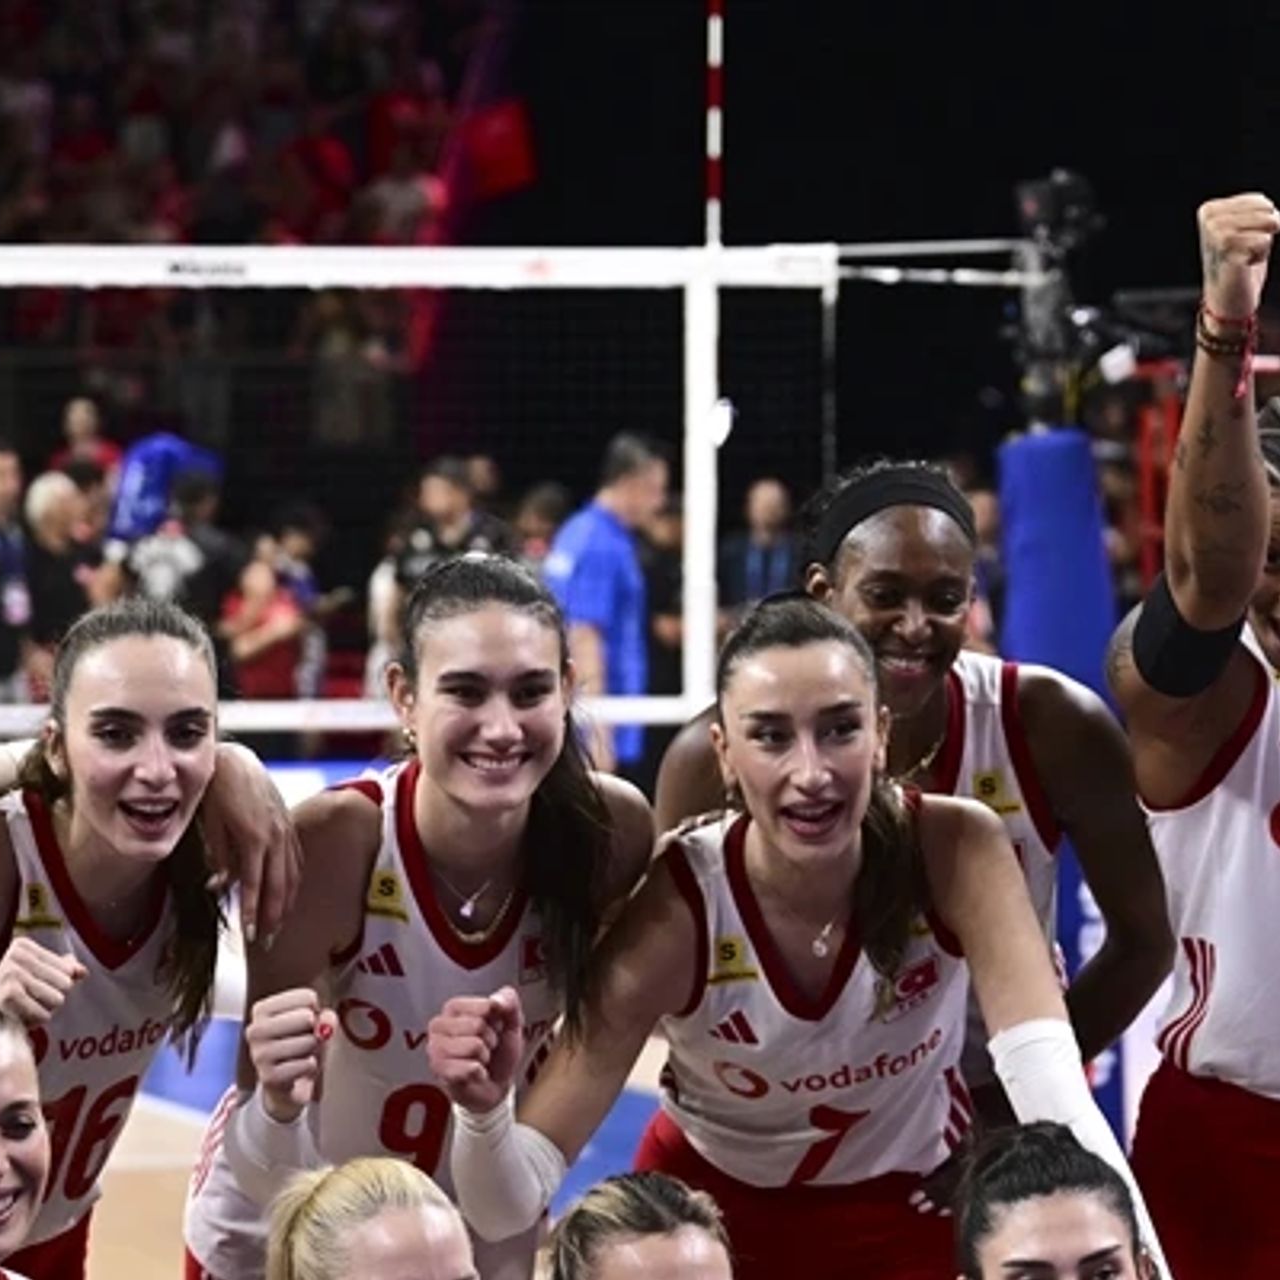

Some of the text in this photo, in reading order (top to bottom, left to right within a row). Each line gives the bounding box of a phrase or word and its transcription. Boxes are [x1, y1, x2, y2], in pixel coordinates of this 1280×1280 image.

[378, 877, 395, 897] S
[720, 942, 736, 961] S
[781, 1028, 942, 1093] vodafone
[379, 1083, 453, 1180] 9
[787, 1103, 872, 1186] 7
